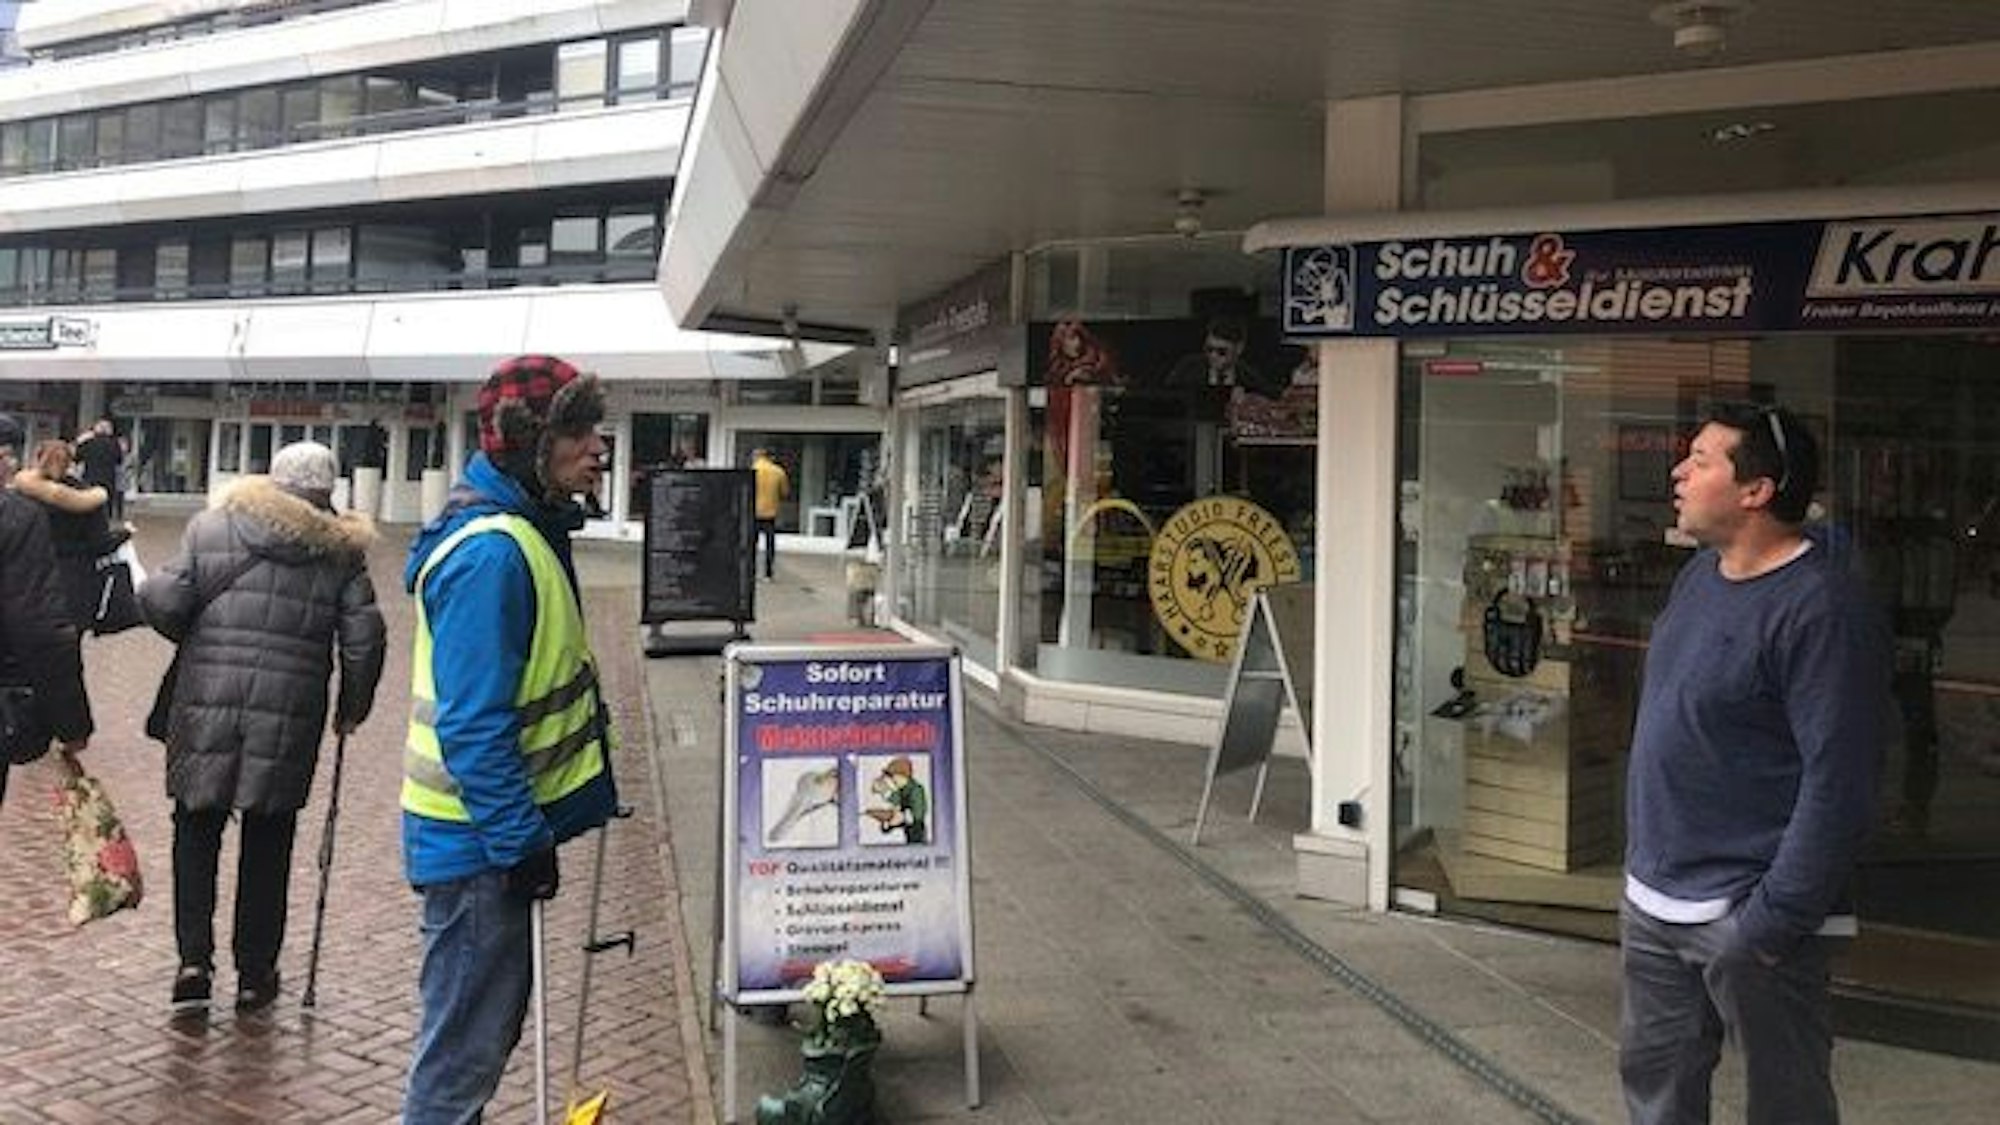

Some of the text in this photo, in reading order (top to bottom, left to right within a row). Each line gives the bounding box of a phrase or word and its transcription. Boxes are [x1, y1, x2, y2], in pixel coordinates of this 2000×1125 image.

[1375, 233, 1577, 288] Schuh &
[1373, 277, 1752, 325] Schlüsseldienst
[806, 662, 887, 684] Sofort
[744, 690, 947, 715] Schuhreparatur
[750, 861, 780, 876] TOP
[786, 857, 929, 876] Qualitätsmaterial
[786, 881, 921, 897] Schuhreparaturen
[786, 901, 904, 917] Schlüsseldienst
[786, 921, 903, 937] Gravur-Express
[787, 941, 849, 955] Stempel
